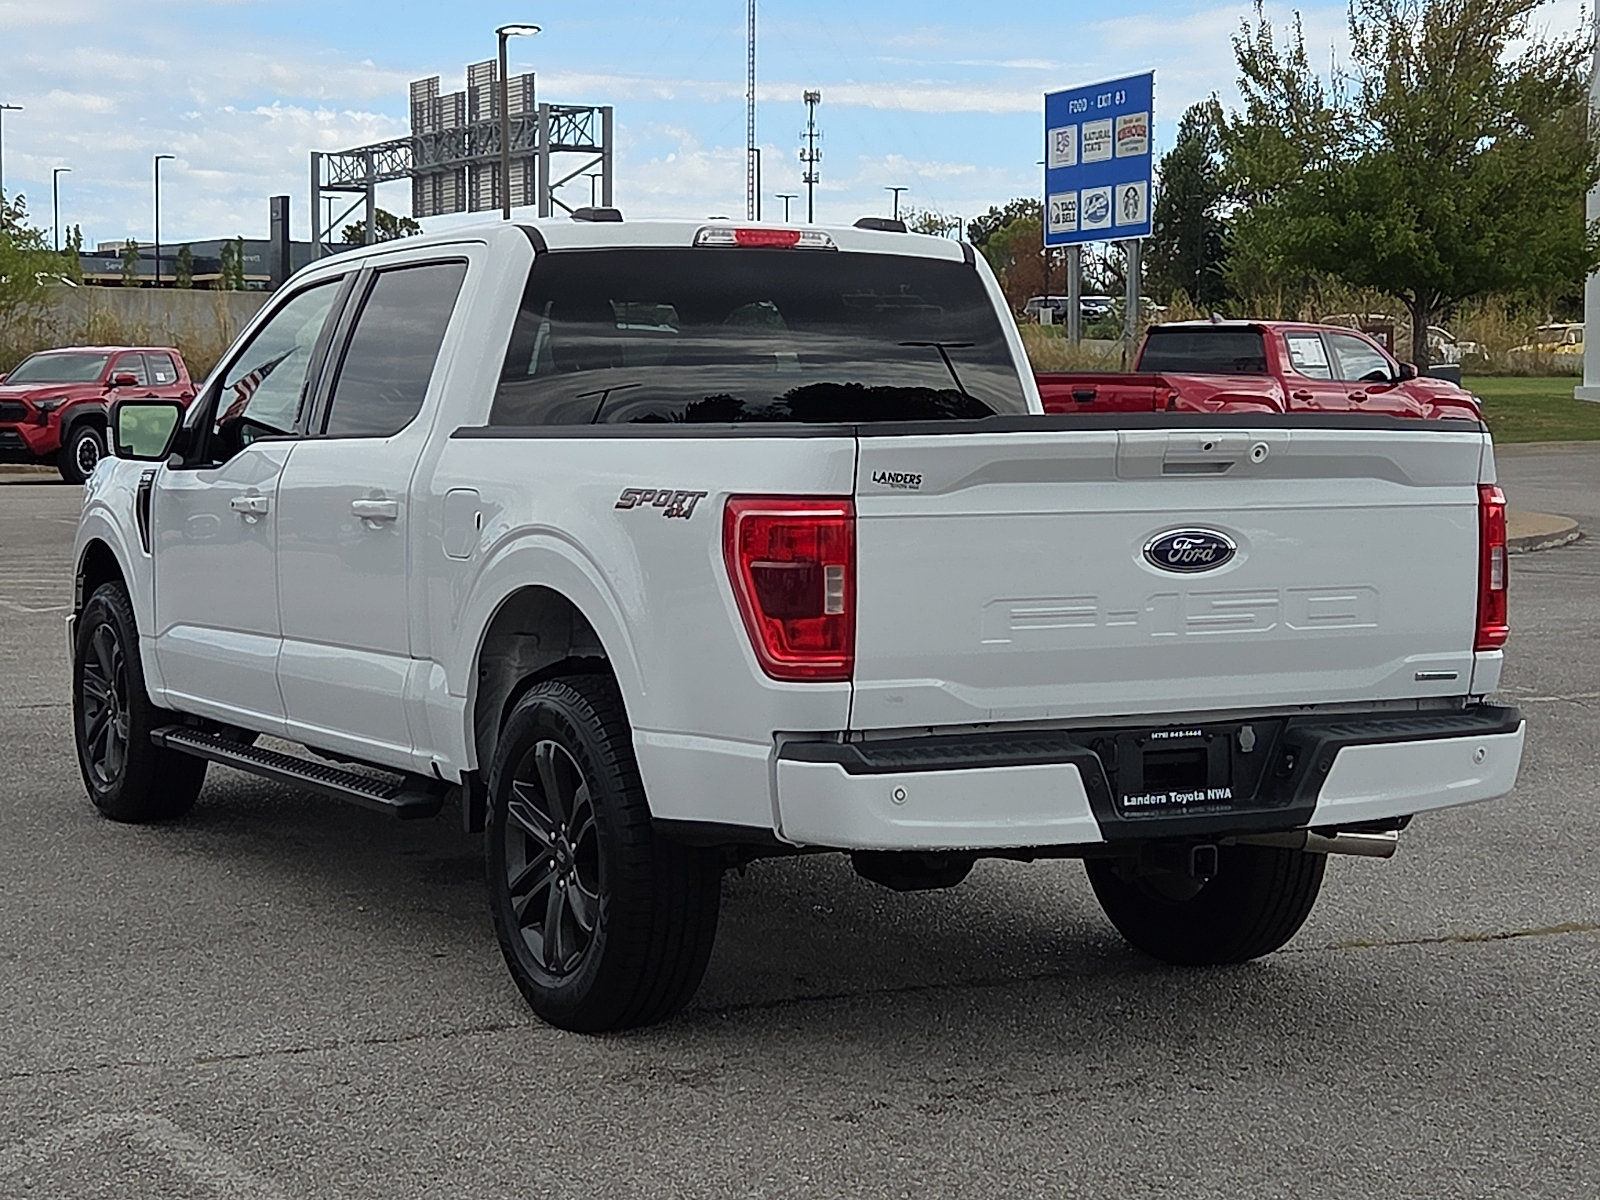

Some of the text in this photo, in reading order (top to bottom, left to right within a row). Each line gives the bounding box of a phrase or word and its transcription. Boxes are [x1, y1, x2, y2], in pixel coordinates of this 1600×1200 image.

[1069, 98, 1087, 114] FOOD
[1098, 93, 1111, 108] EXIT
[1084, 130, 1111, 142] NATURAL
[1084, 142, 1101, 153] STATE
[1061, 201, 1076, 211] TACO
[1062, 213, 1076, 223] BELL
[872, 471, 922, 484] LANDERS
[614, 487, 709, 520] SPORT
[1167, 537, 1218, 563] Ford
[1124, 787, 1232, 806] Landers Toyota NWA
